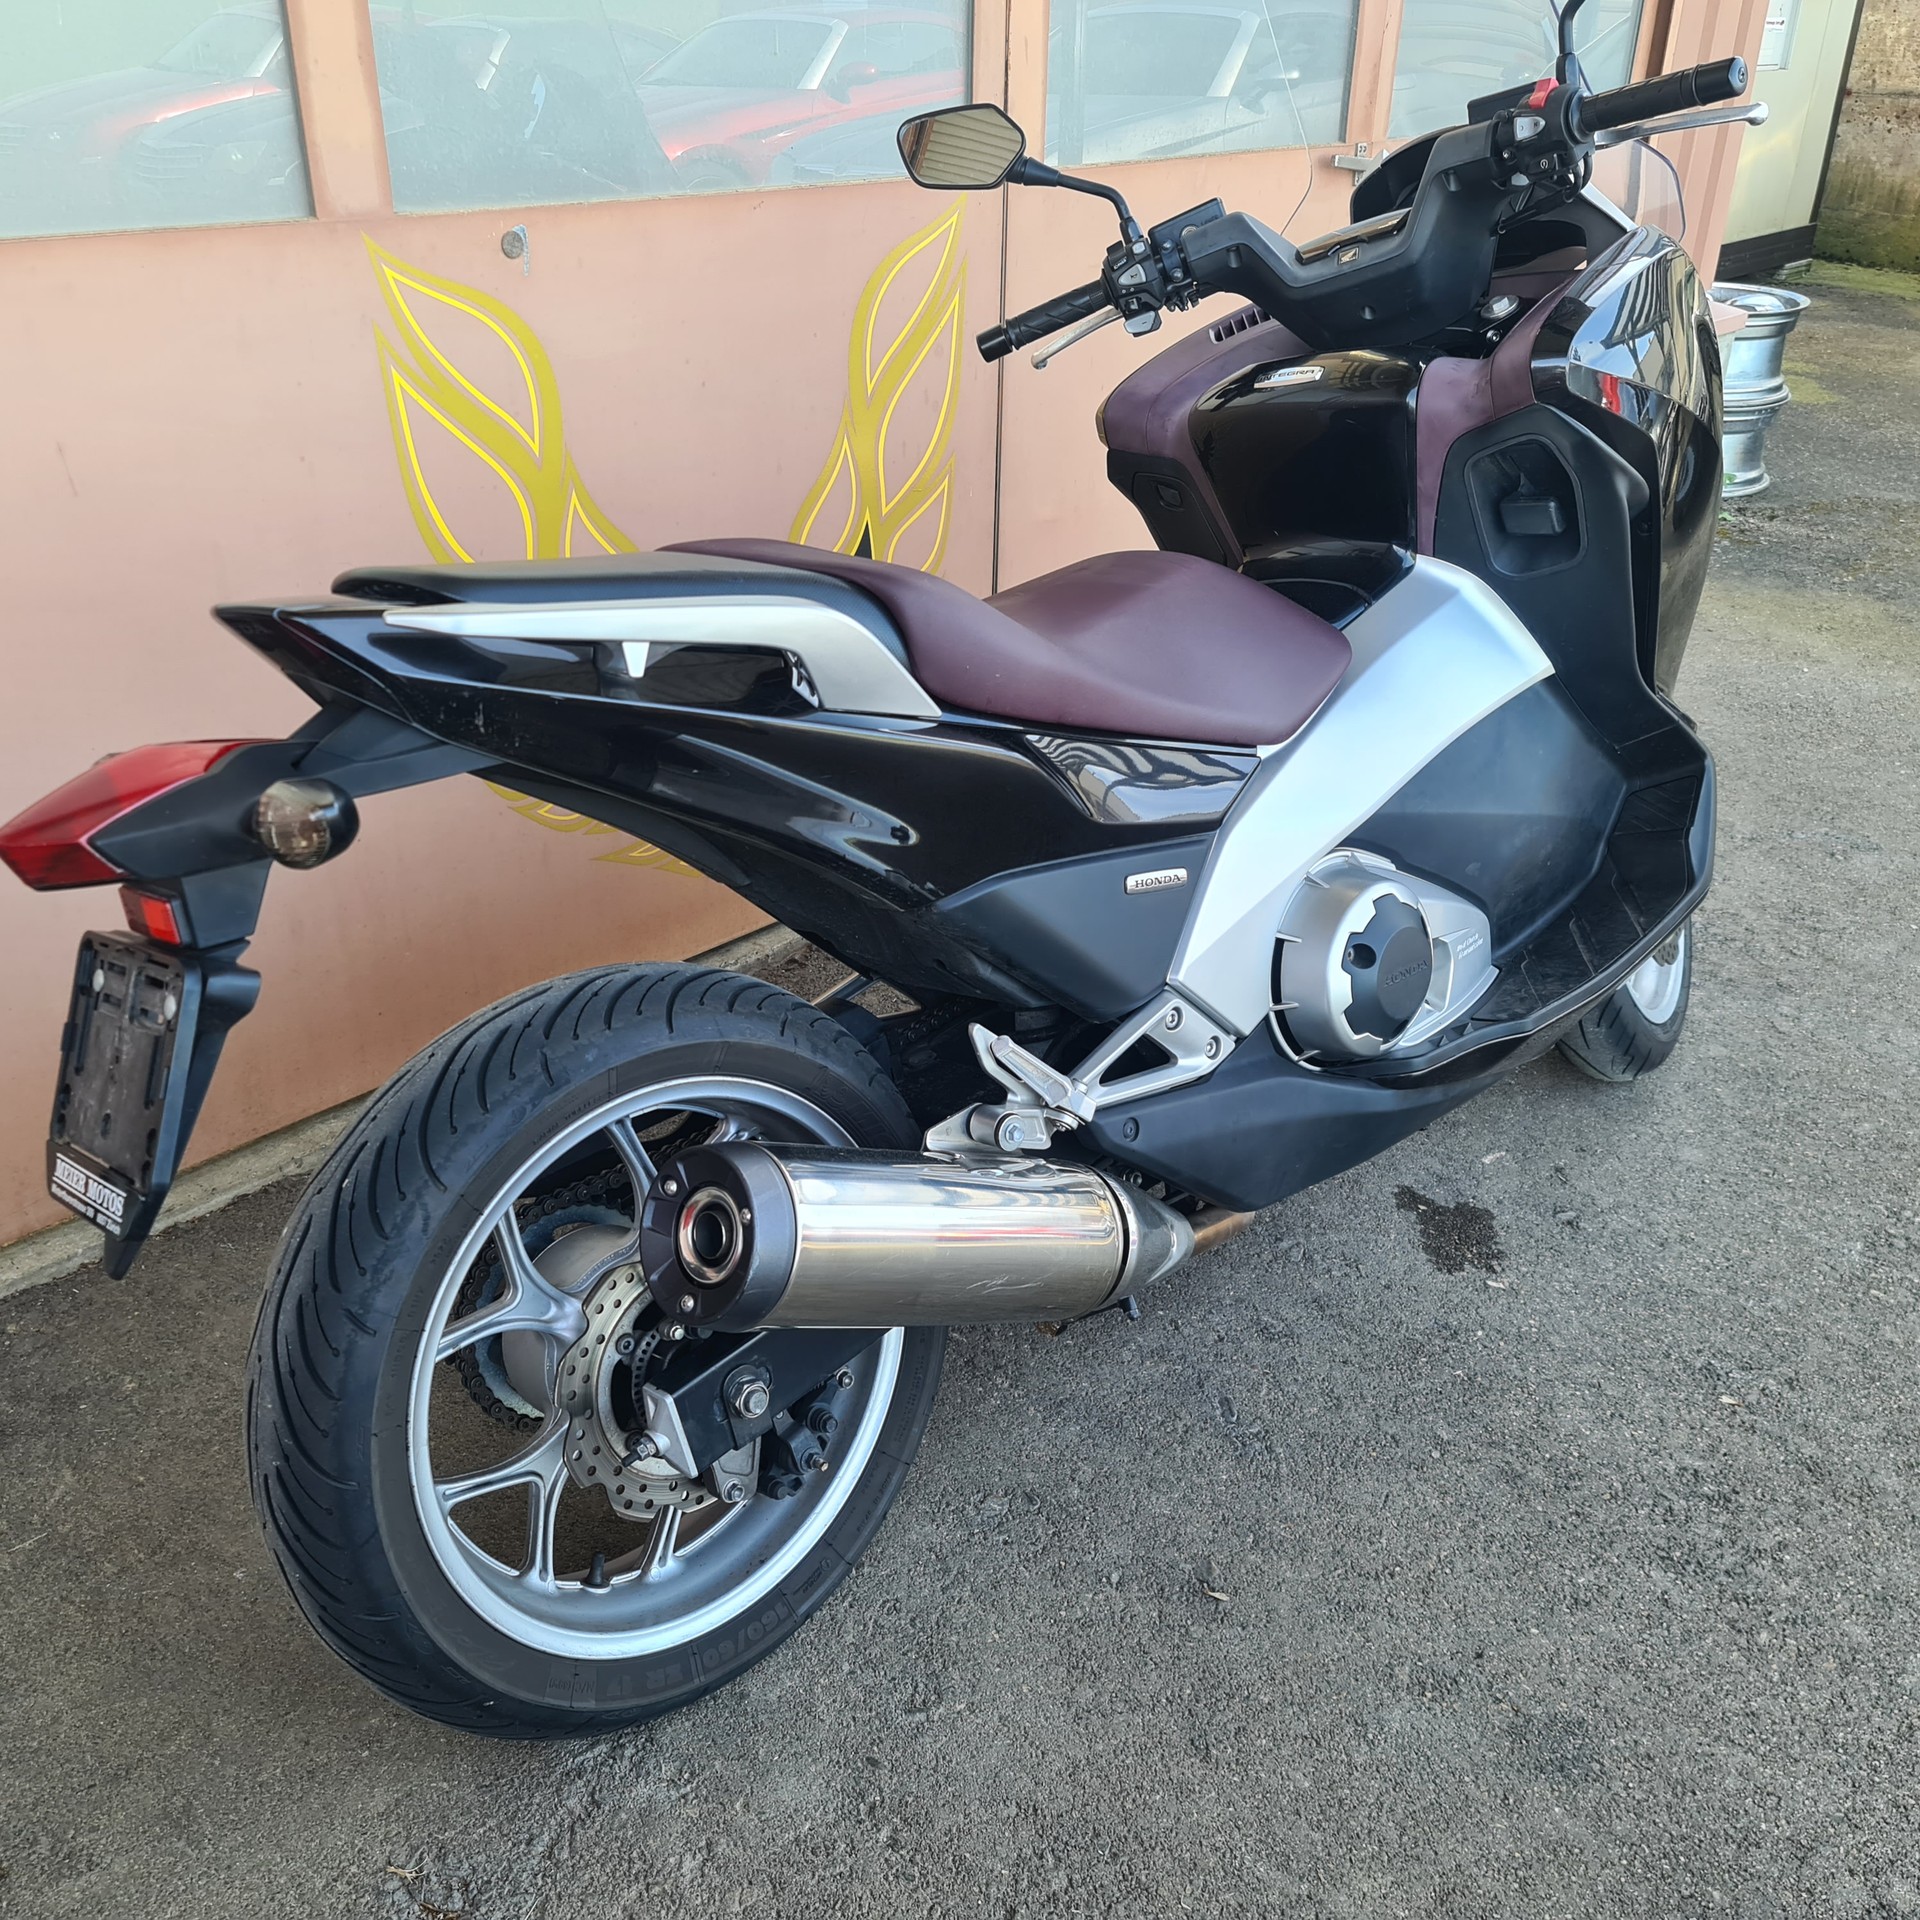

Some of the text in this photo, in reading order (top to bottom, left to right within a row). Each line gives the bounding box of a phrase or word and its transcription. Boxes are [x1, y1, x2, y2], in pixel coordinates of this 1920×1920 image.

[1134, 874, 1182, 889] HONDA
[1384, 960, 1428, 988] HONDA
[86, 1178, 125, 1217] MOTOS
[702, 1602, 790, 1669] 160/60
